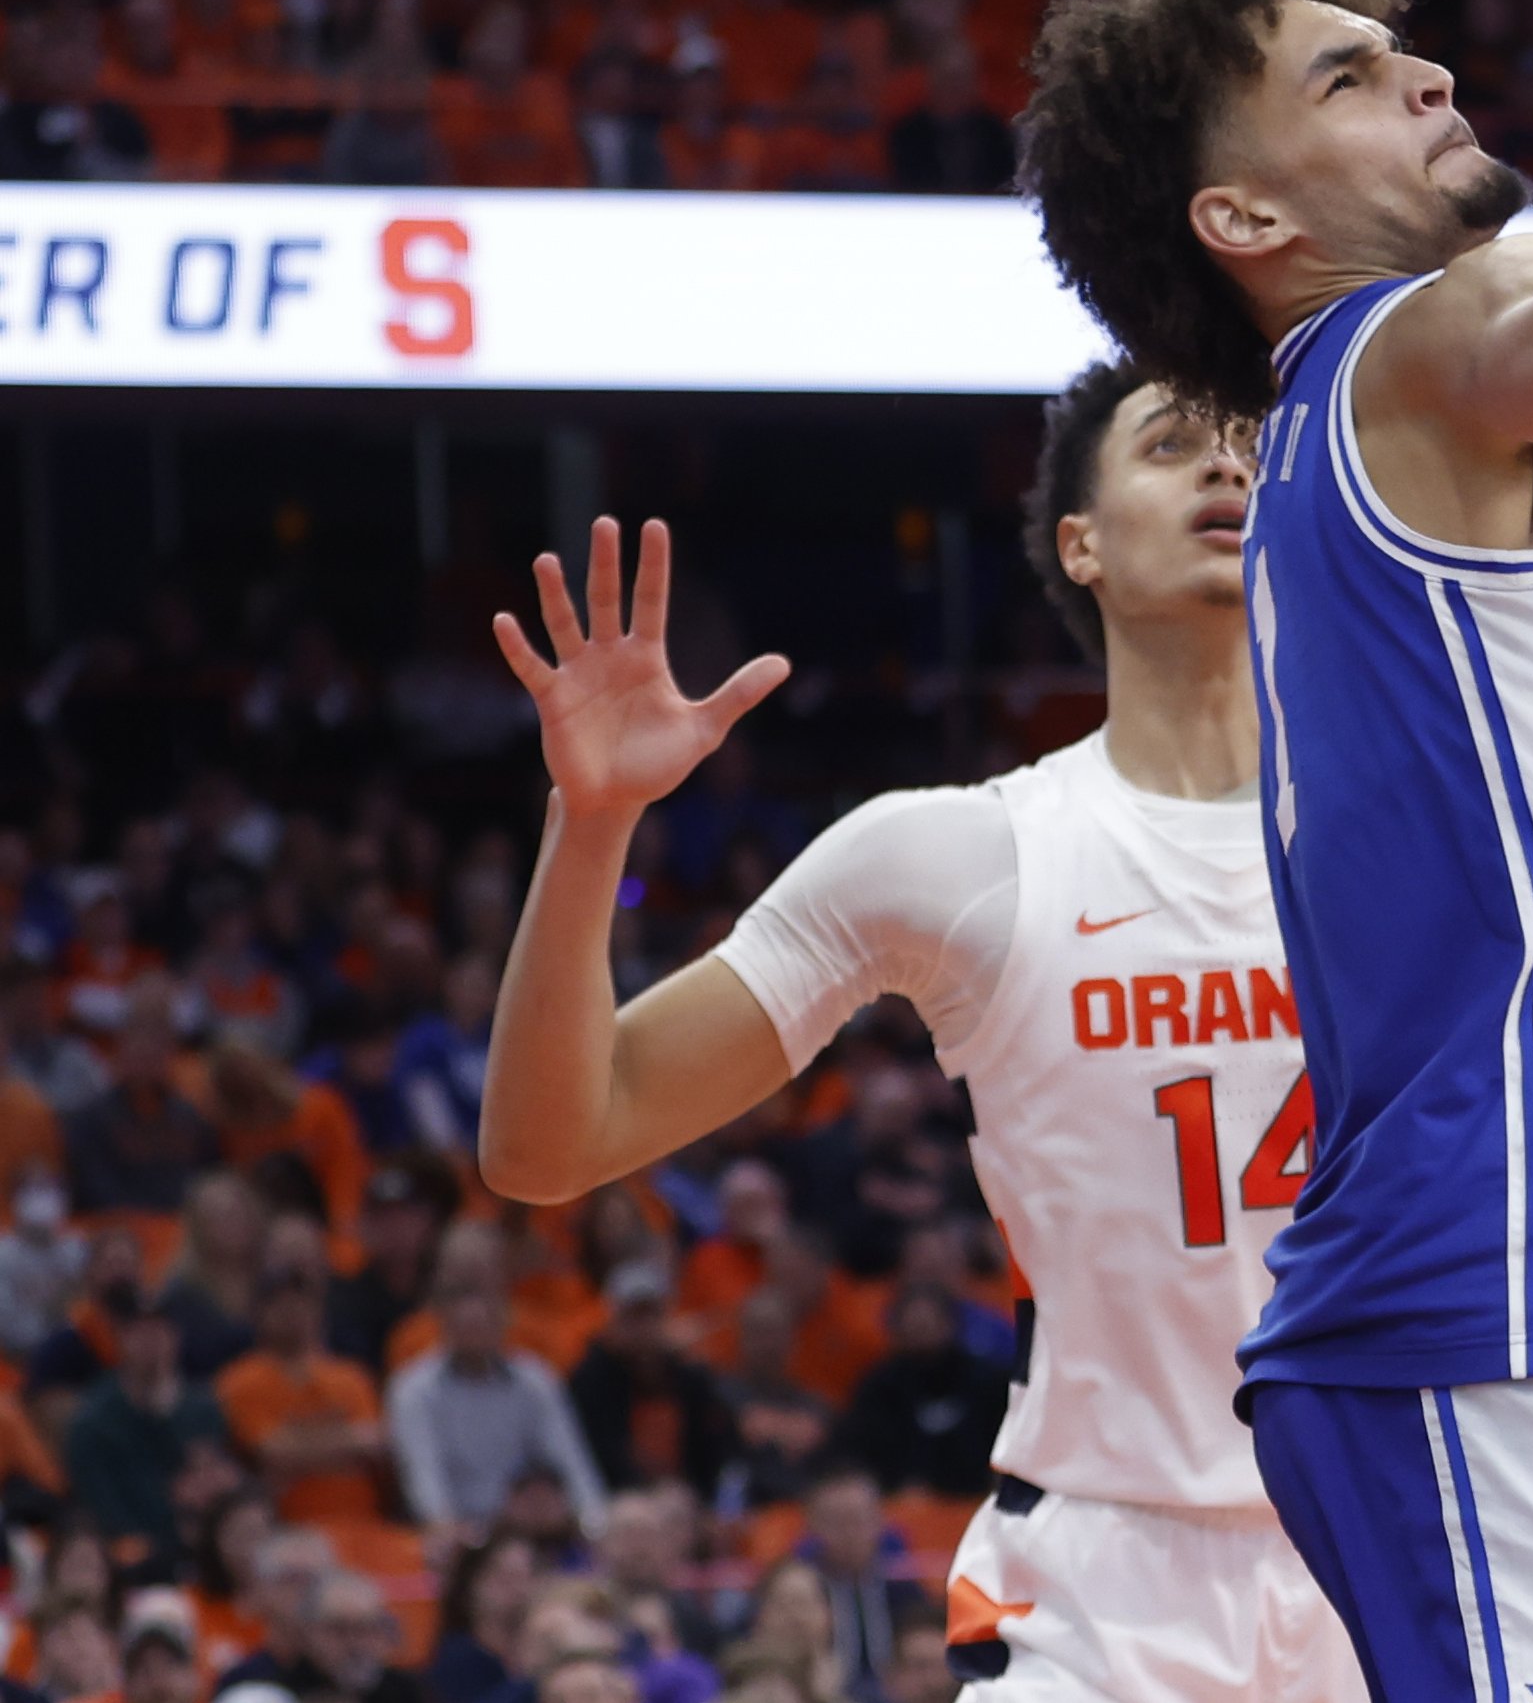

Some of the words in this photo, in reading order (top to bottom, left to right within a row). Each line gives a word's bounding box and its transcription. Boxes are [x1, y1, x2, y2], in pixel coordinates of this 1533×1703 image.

[164, 238, 324, 335] OF
[380, 218, 474, 356] S
[1071, 966, 1303, 1051] ORAN
[1153, 1069, 1318, 1248] 14
